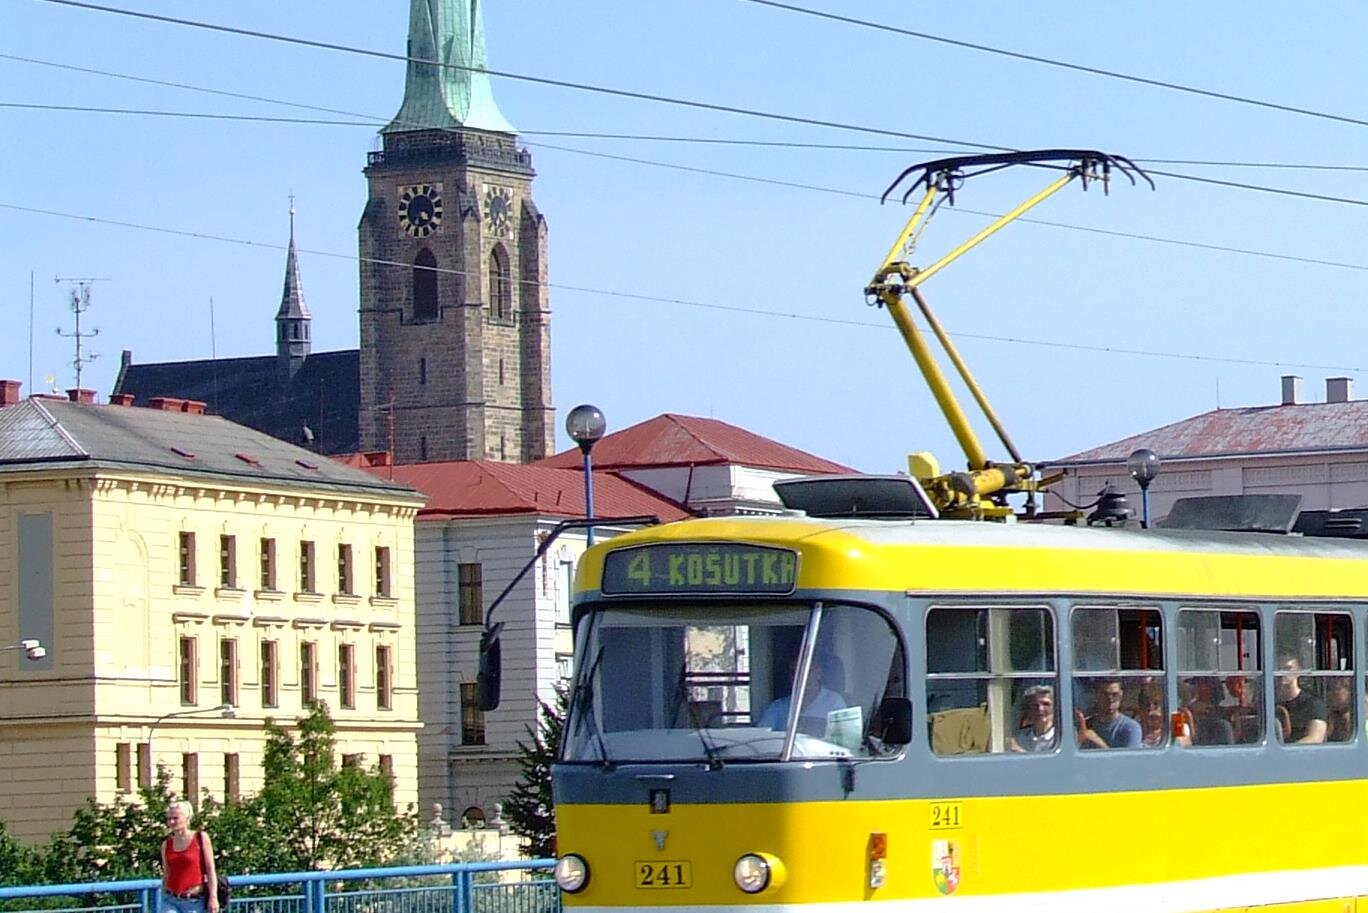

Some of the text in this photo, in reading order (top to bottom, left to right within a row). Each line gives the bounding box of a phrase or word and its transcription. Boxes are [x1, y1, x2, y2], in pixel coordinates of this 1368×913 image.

[628, 553, 651, 585] 4
[932, 805, 961, 826] 241
[640, 864, 686, 885] 241
